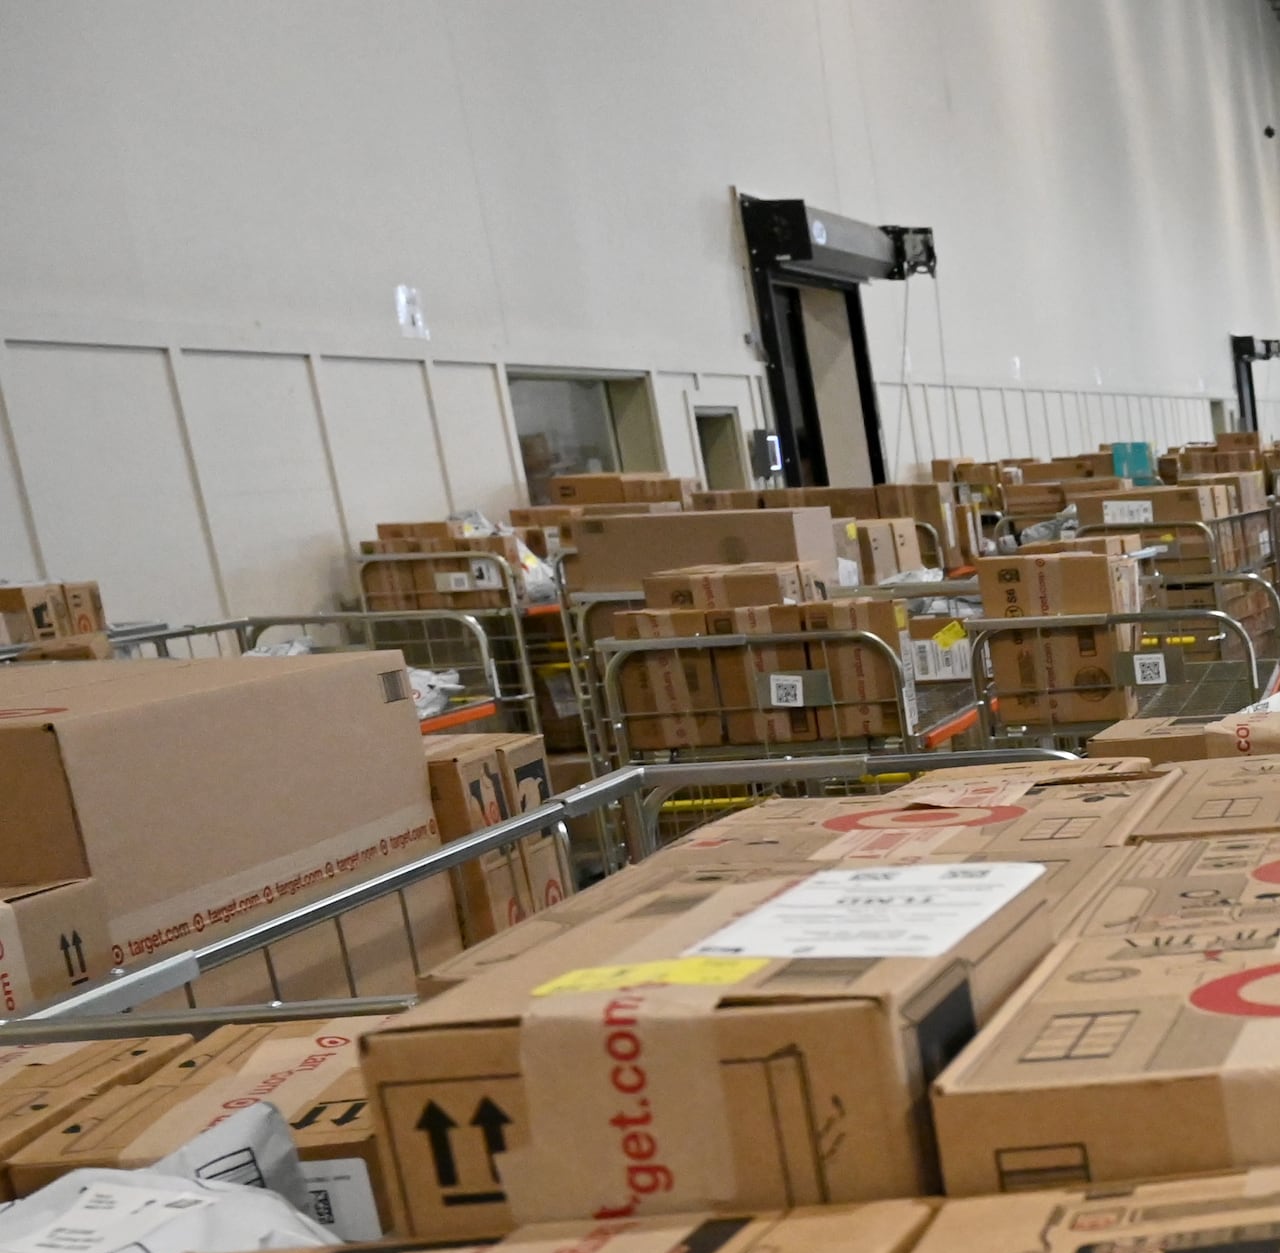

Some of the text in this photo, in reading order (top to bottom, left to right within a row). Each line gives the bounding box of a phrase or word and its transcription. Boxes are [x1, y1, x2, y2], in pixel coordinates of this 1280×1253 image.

[128, 822, 428, 955] target.com target.com target.com target.com target.com
